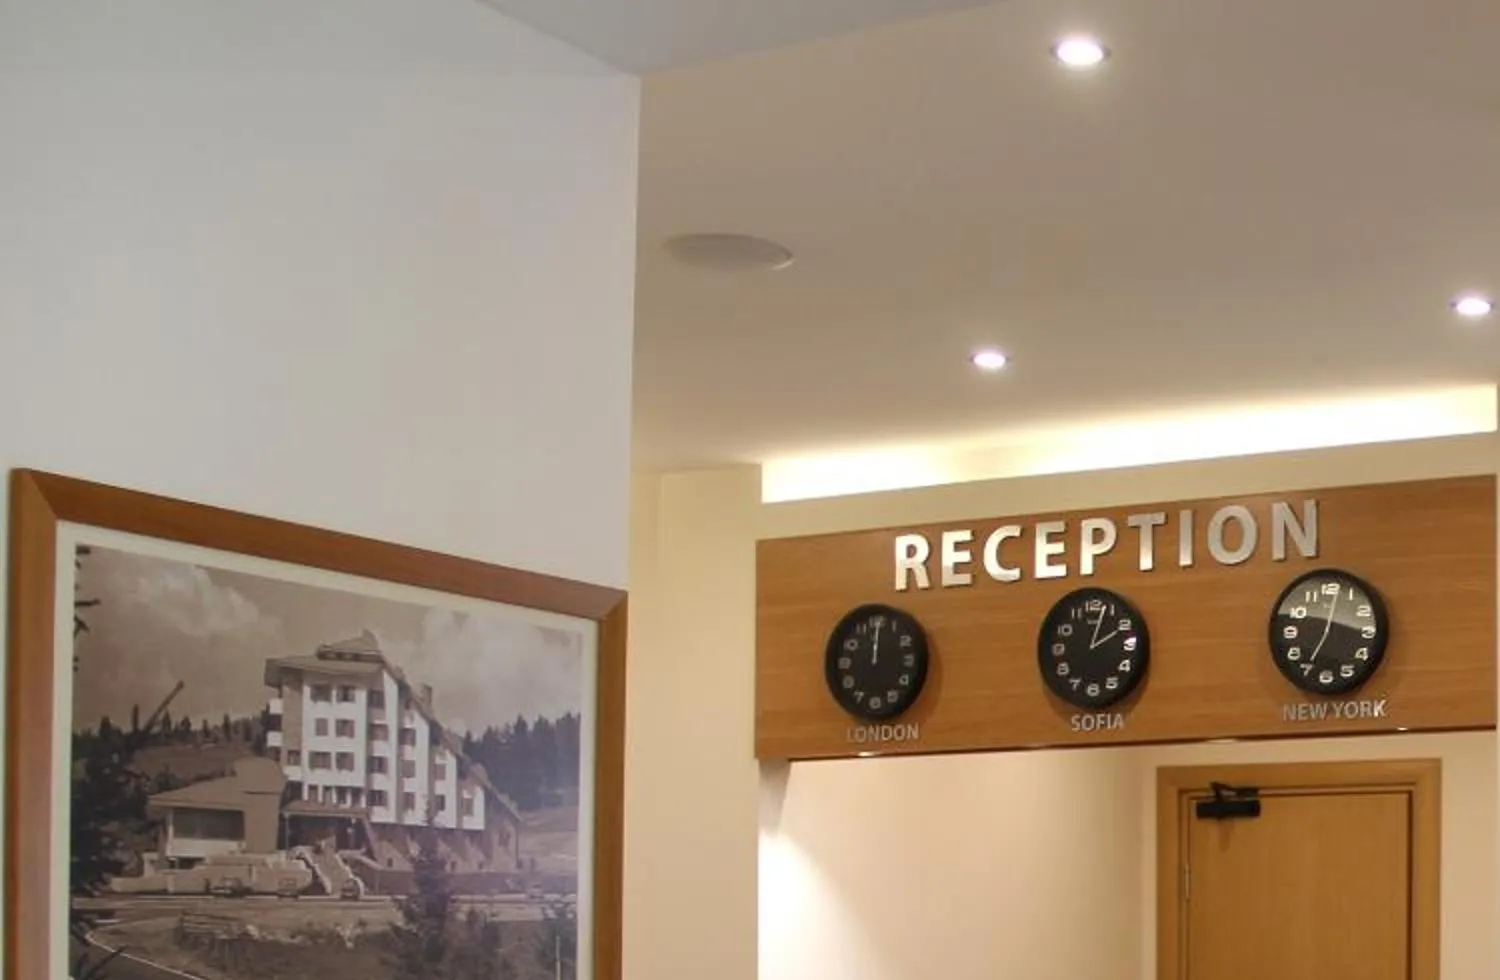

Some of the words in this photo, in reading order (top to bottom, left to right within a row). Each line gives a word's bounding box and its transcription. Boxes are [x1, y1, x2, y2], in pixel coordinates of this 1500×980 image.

[894, 499, 1319, 591] RECEPTION
[1321, 583, 1340, 595] 12
[1349, 588, 1353, 600] 1
[1305, 591, 1317, 602] 11
[1085, 599, 1106, 611] 12
[1110, 604, 1115, 615] 1
[1357, 605, 1371, 617] 2
[1071, 608, 1082, 618] 11
[1290, 606, 1307, 619] 10
[1057, 624, 1073, 636] 10
[1118, 619, 1132, 630] 2
[1283, 626, 1298, 638] 9
[1361, 626, 1376, 639] 3
[1052, 643, 1065, 655] 9
[1124, 636, 1137, 651] 3
[1287, 647, 1301, 660] 8
[1355, 647, 1369, 661] 4
[1057, 663, 1070, 675] 8
[1118, 659, 1131, 672] 4
[1300, 664, 1313, 676] 7
[1340, 665, 1355, 677] 5
[1105, 677, 1118, 689] 5
[1319, 671, 1334, 683] 6
[1069, 679, 1081, 690] 7
[1086, 684, 1100, 696] 6
[854, 692, 864, 703] 7
[1282, 702, 1328, 721] NEW
[1332, 699, 1388, 719] YORK
[1070, 713, 1125, 731] SOFIA
[846, 723, 920, 743] LONDON
